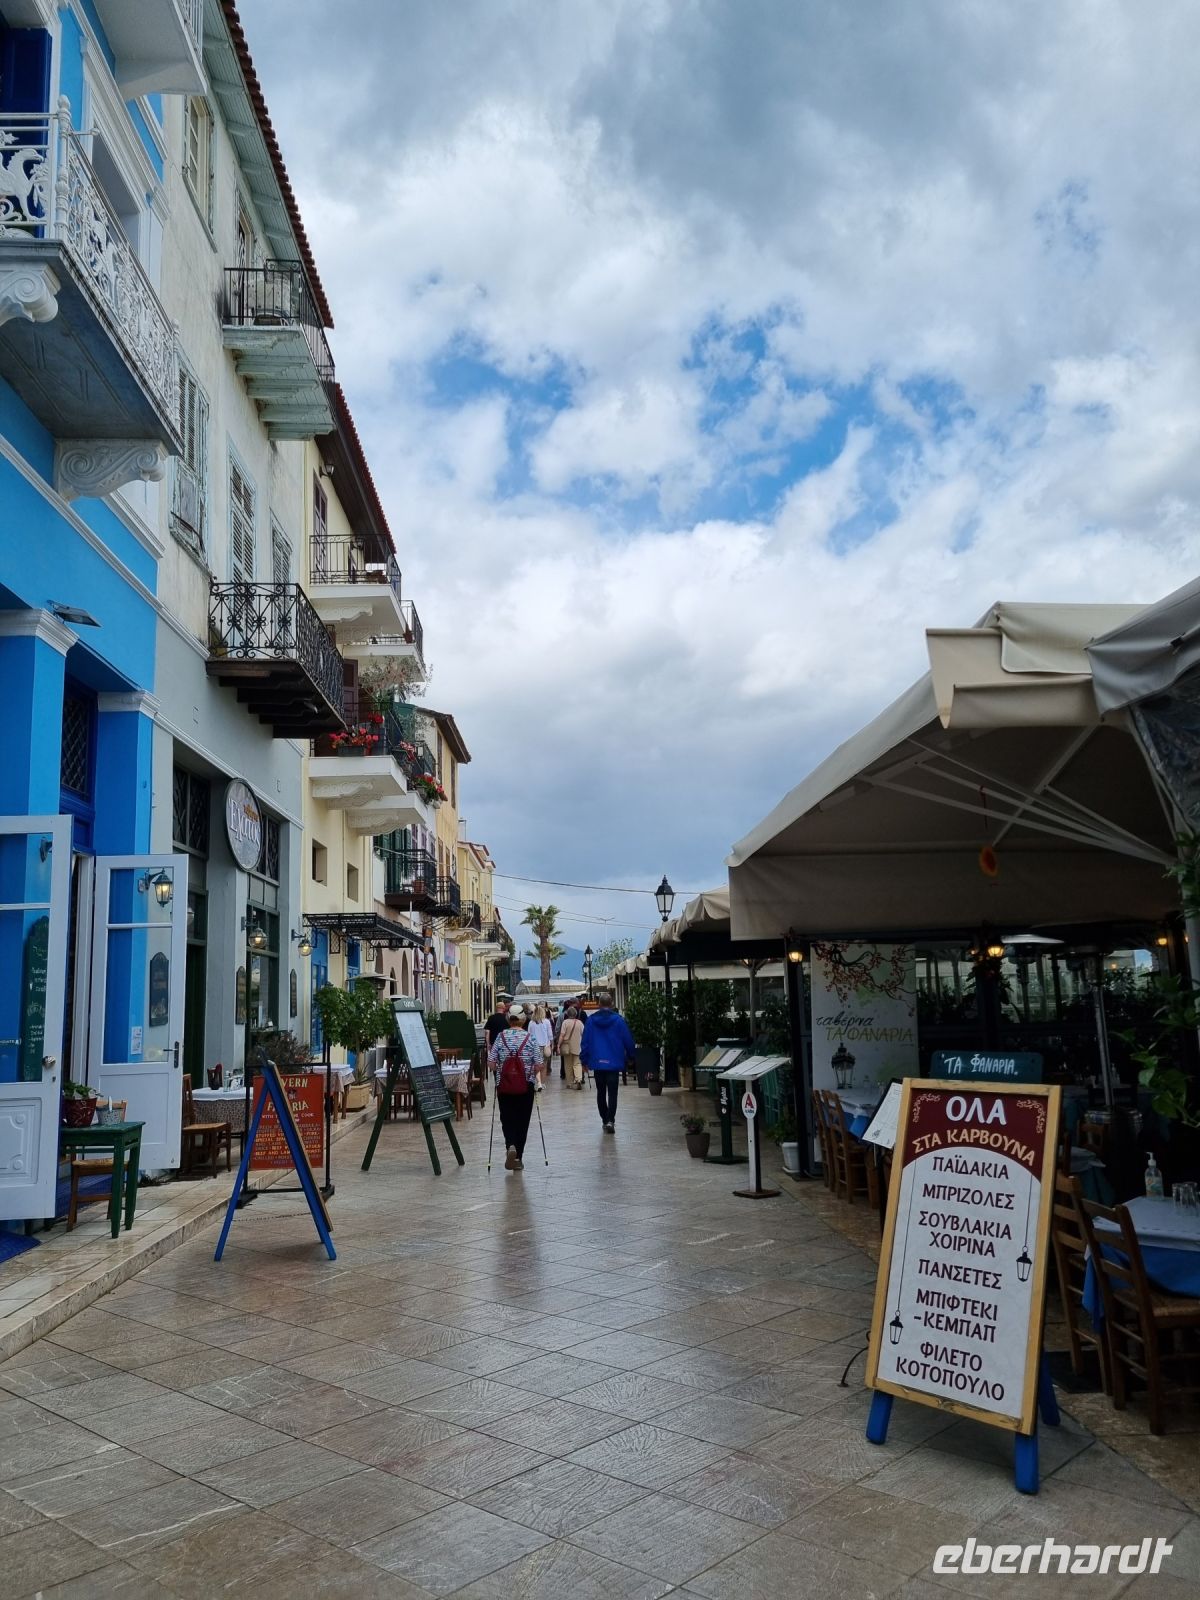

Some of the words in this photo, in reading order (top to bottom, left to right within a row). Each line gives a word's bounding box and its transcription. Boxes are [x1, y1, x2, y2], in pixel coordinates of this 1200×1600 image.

[826, 1026, 844, 1041] ΤΑ
[847, 1026, 914, 1042] ΦΑΝΑΡΙΑ
[945, 1096, 1006, 1125] ΟΛΑ
[912, 1132, 942, 1154] ΣΤΑ
[947, 1128, 1036, 1167] ΚΑΡΒΟΥΝΑ
[932, 1154, 1010, 1180] ΠΑΪΔΑΚΙΑ
[922, 1183, 1015, 1211] ΜΠΡΙΖΟΛΕΣ
[918, 1210, 1012, 1240] ΣΟΥΒΛΑΚΙΑ
[929, 1231, 996, 1258] ΧΟΙΡΙΝΑ
[918, 1259, 1003, 1290] ΠΑΝΣΕΤΕΣ
[916, 1288, 998, 1321] ΜΠΙΦΤΕΚΙ
[913, 1311, 996, 1343] -ΚΕΜΠΑΠ
[920, 1341, 983, 1372] ΦΙΛΕΤΟ
[896, 1356, 1005, 1401] ΚΟΤΟΠΟΥΛΟ
